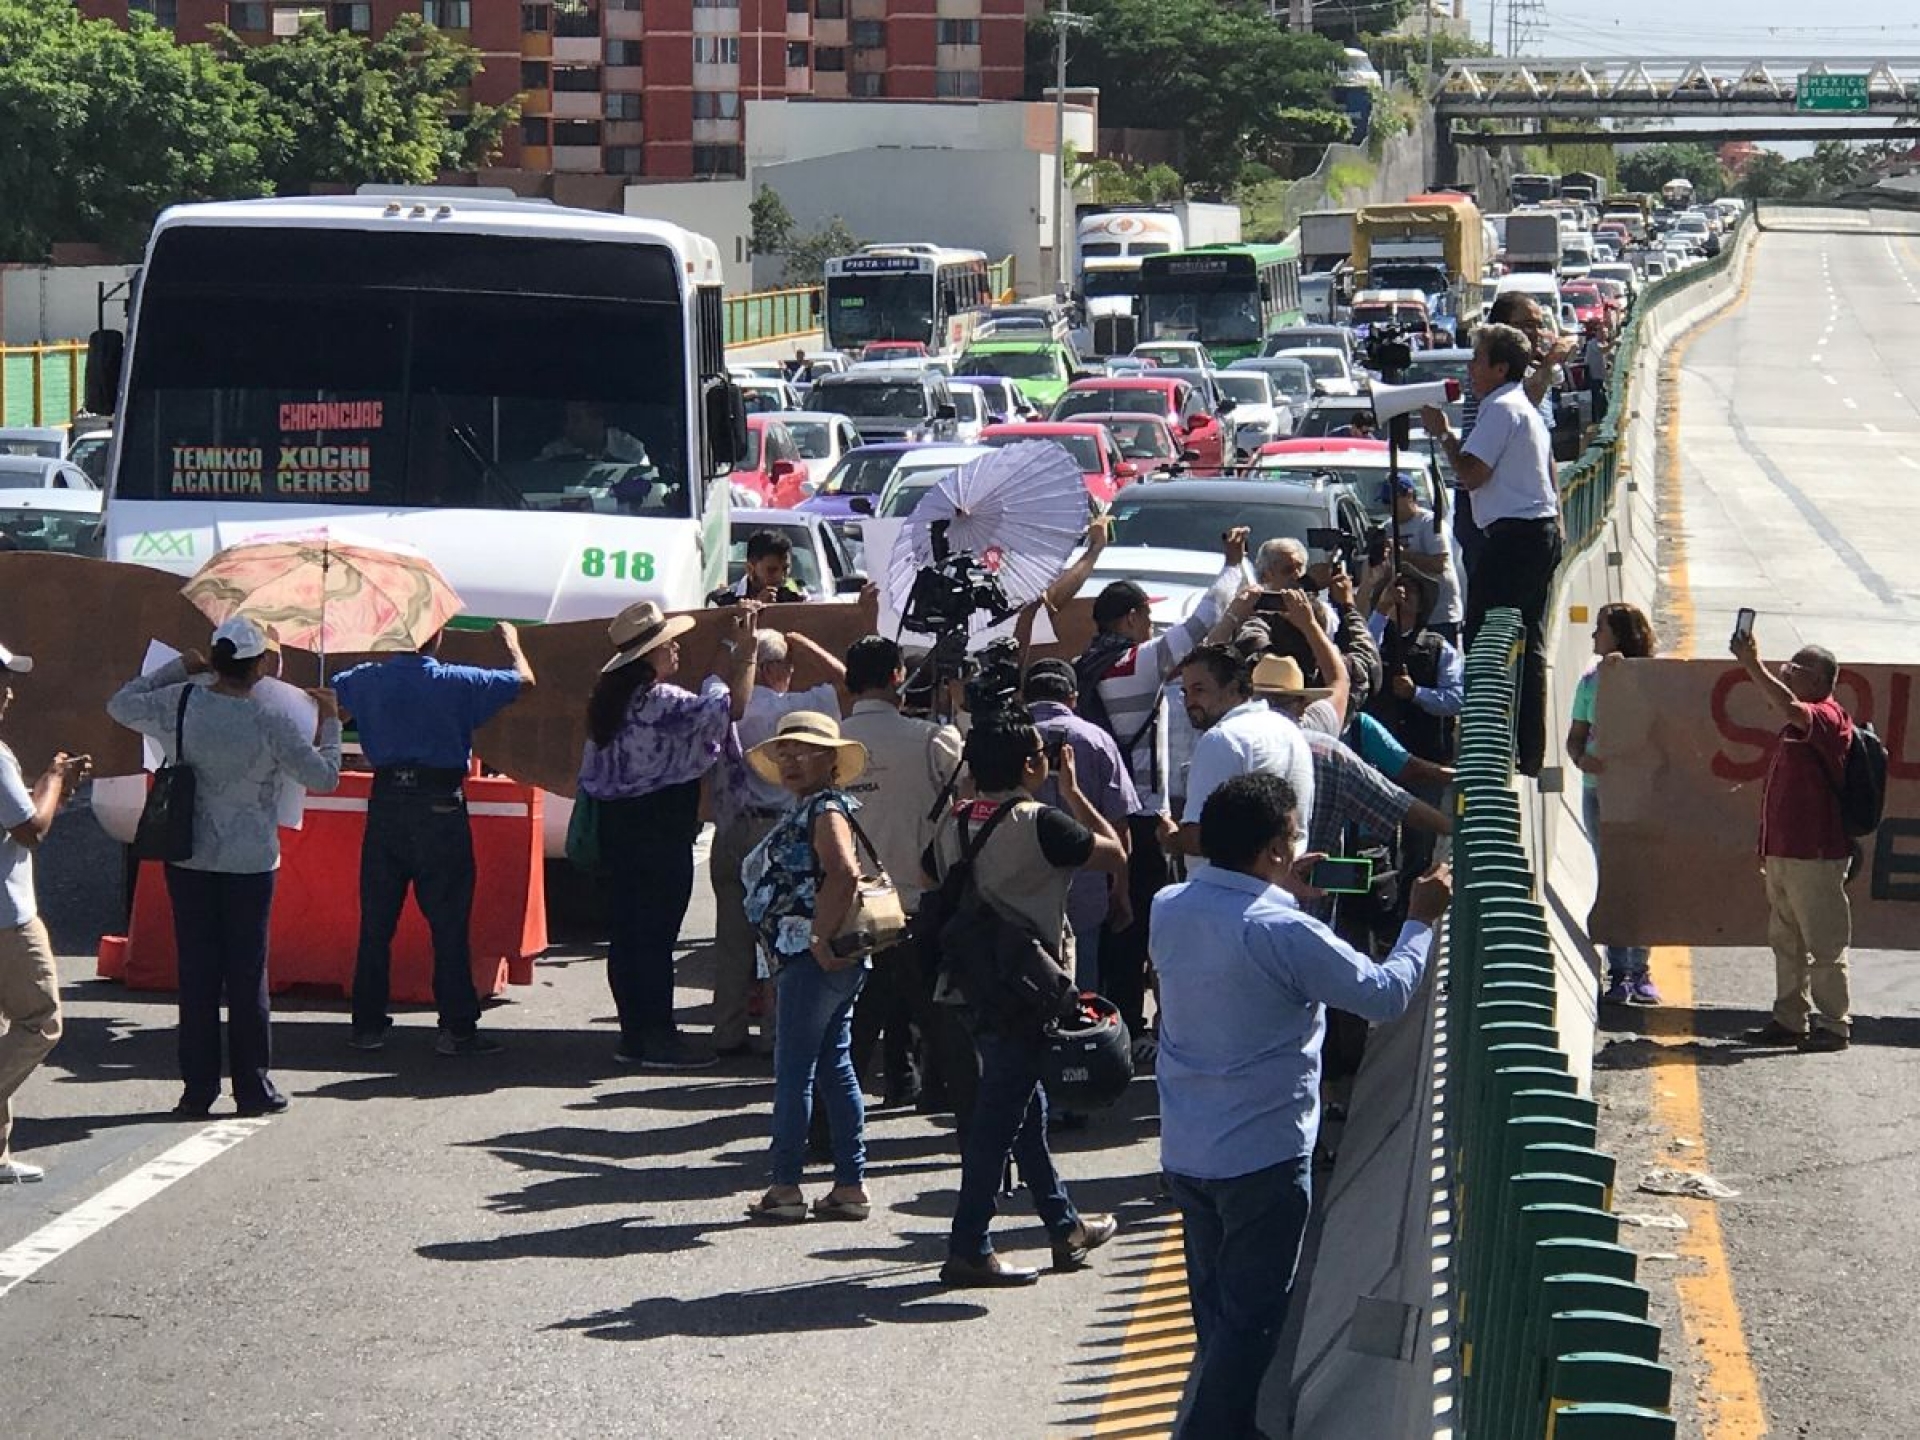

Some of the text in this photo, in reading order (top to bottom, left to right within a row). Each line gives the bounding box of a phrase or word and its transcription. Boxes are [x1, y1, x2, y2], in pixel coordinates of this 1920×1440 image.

[279, 401, 383, 431] CHICONCUAC
[172, 447, 370, 470] TEMIXCO XOCHI
[172, 471, 370, 494] ACATLIPA CERESO
[582, 547, 655, 582] 818
